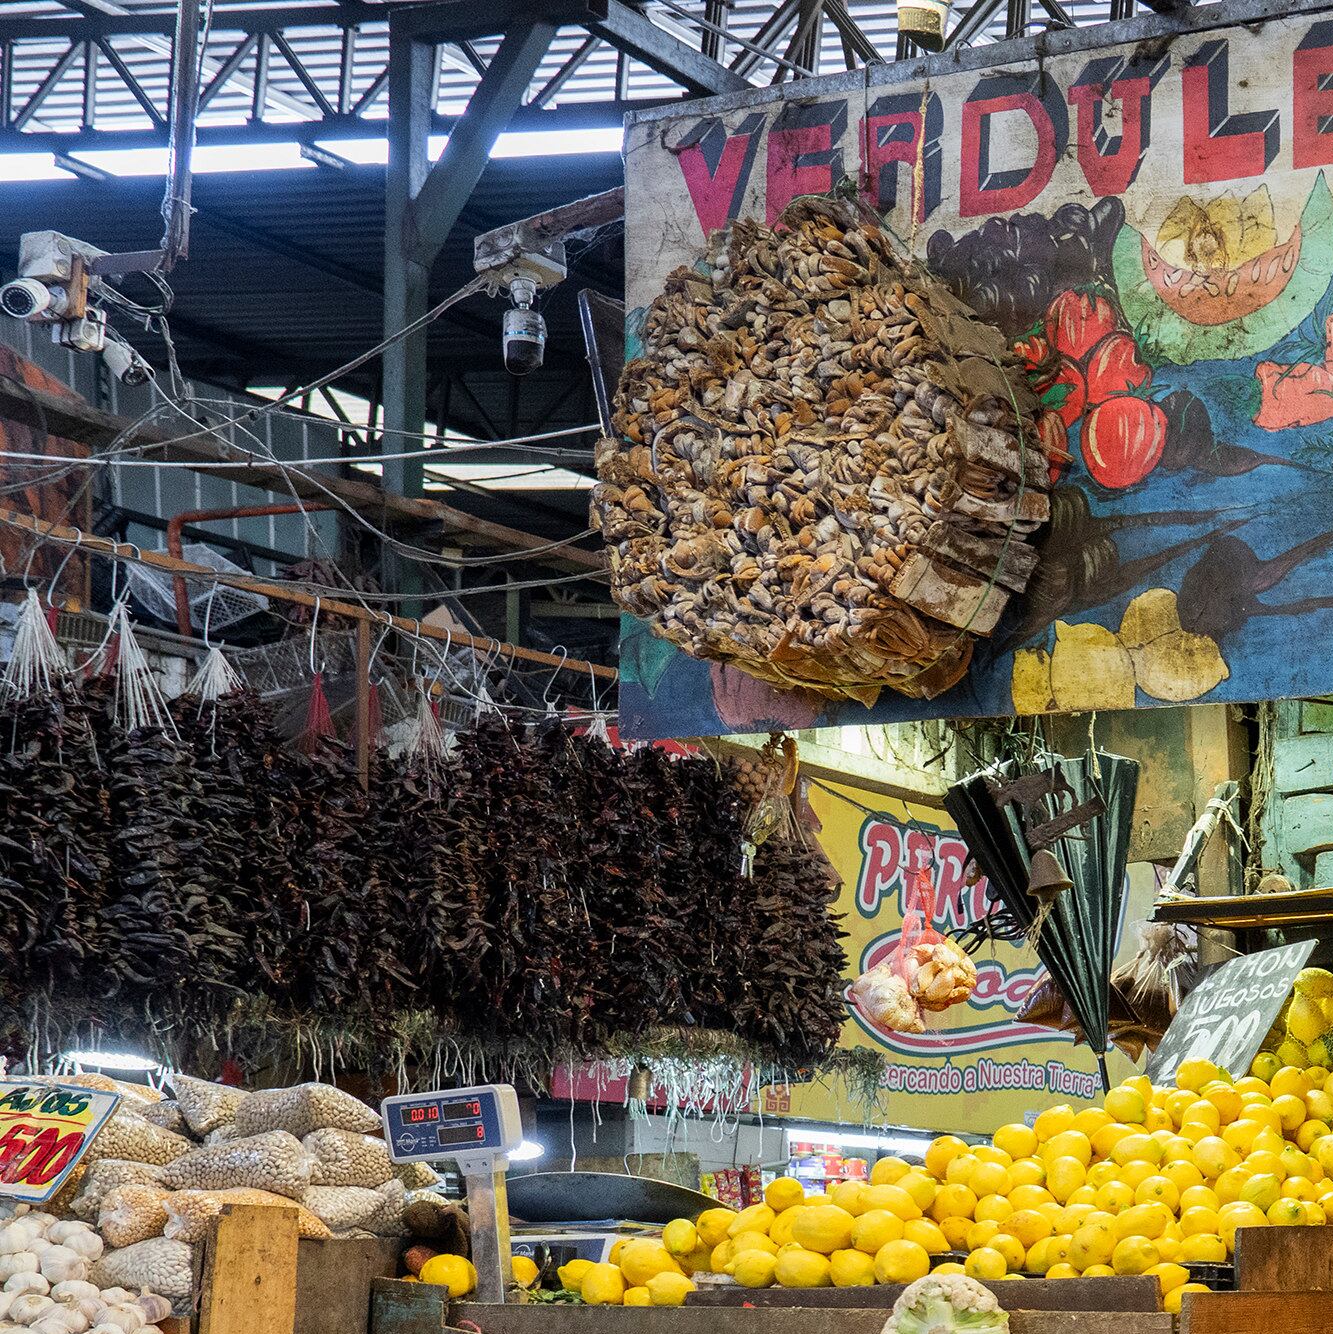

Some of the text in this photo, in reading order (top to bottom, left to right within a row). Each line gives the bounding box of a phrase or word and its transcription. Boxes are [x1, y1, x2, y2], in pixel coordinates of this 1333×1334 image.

[1181, 976, 1290, 1018] JUGOSOS
[882, 1060, 961, 1094] ercando
[965, 1070, 976, 1090] a
[979, 1062, 1046, 1090] Nuestra
